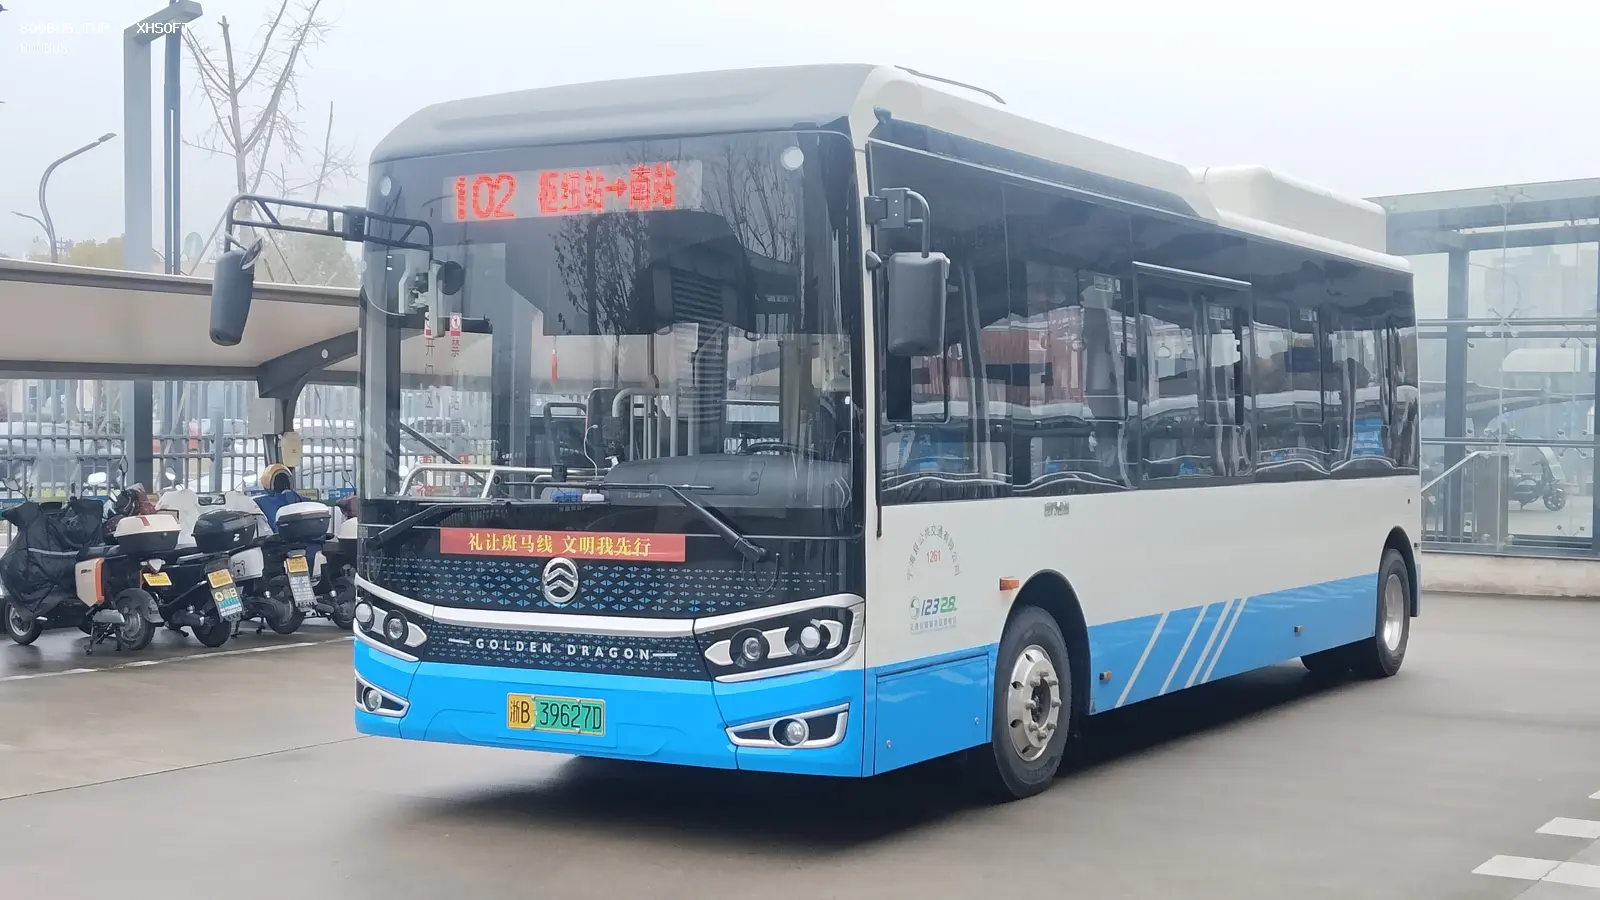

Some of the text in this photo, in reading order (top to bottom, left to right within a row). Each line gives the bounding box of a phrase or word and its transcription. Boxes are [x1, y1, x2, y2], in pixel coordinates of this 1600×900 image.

[455, 172, 517, 220] 102
[629, 161, 676, 209] 南站
[467, 532, 652, 556] 礼让斑马线 文明我先行
[926, 549, 941, 564] 1261
[920, 595, 957, 617] 12328
[475, 638, 650, 661] GOLDEN DRAGON
[509, 700, 602, 729] 浙B 39627D
